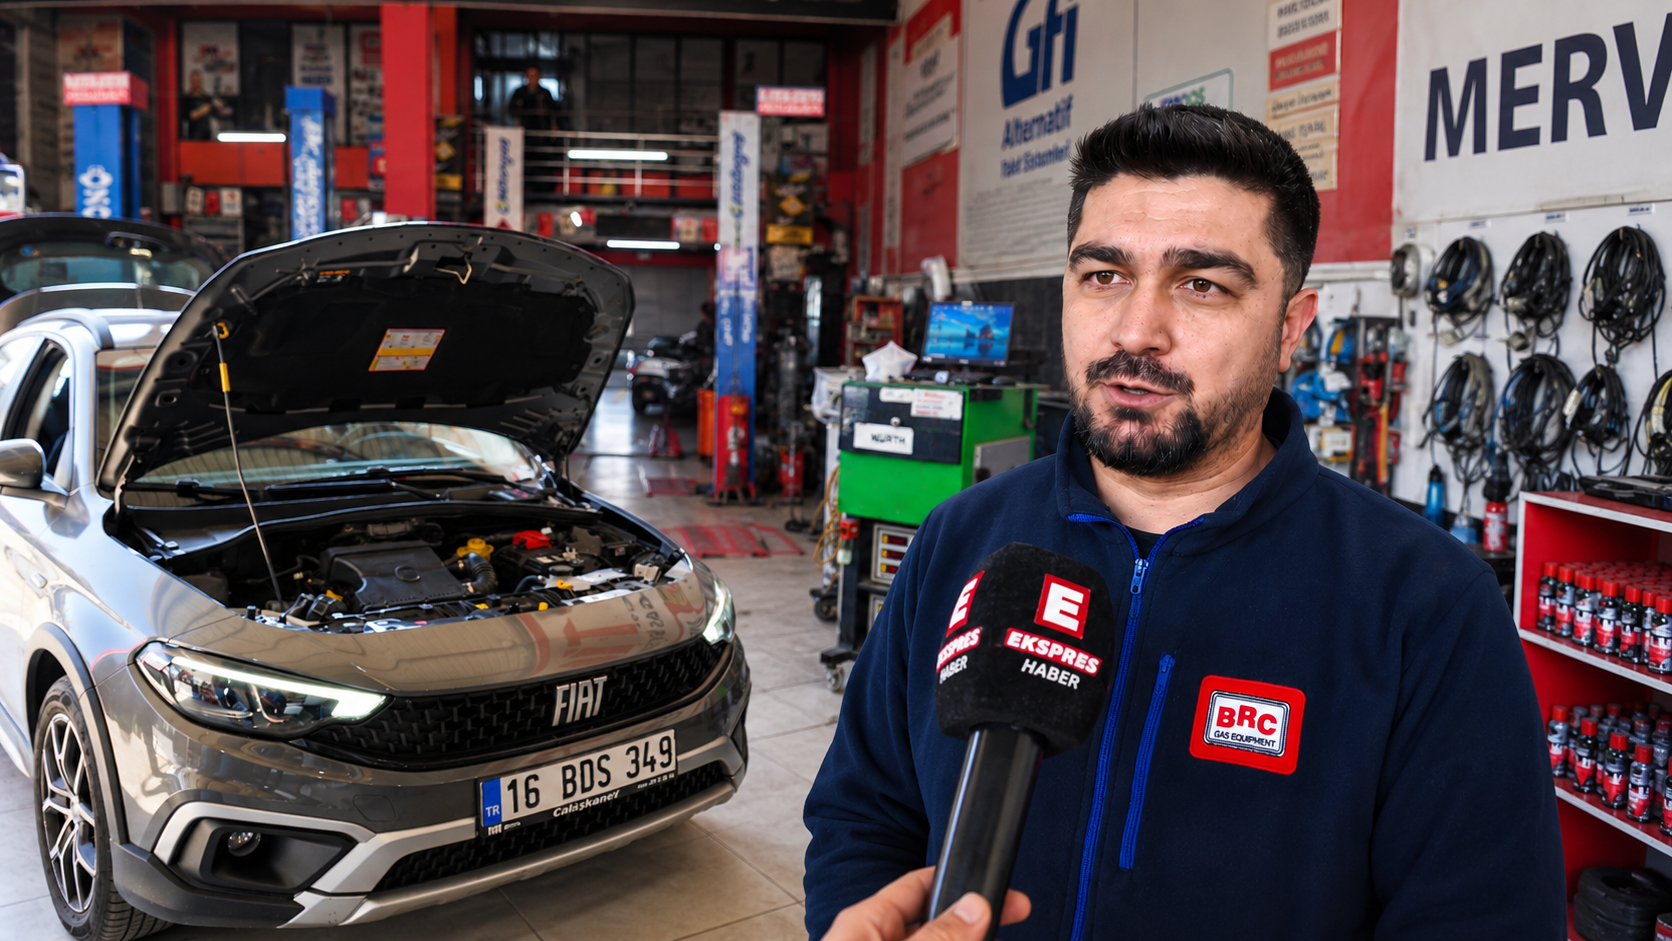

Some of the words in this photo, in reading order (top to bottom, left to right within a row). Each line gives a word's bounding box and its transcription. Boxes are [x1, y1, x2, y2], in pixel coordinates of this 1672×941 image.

[1423, 12, 1672, 163] MERV
[949, 578, 978, 629] E
[1042, 582, 1084, 632] E
[1006, 631, 1100, 675] EKSPRES
[1020, 658, 1081, 690] HABER
[552, 675, 608, 727] FIAT
[1216, 704, 1278, 736] BRC
[1213, 730, 1230, 740] GAS
[1230, 732, 1276, 748] EQUIPMENT
[507, 774, 540, 814] 16
[562, 754, 611, 800] BDS
[625, 736, 672, 779] 349
[485, 804, 501, 818] TR
